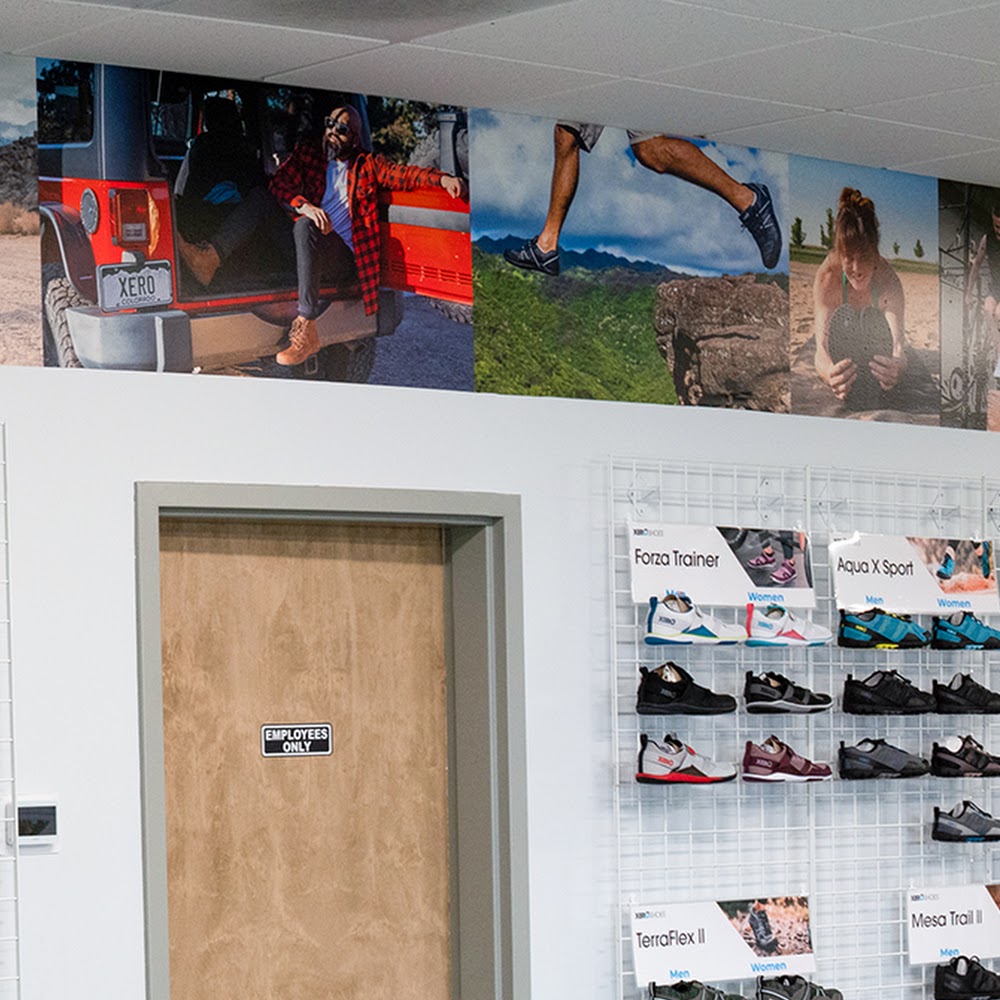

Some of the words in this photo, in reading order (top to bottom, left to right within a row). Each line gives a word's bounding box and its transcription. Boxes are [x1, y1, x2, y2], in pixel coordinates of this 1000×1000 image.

[118, 275, 155, 297] XERO
[635, 548, 670, 565] Forza
[672, 550, 720, 567] Trainer
[837, 557, 869, 576] Aqua
[871, 558, 881, 574] X
[883, 560, 914, 577] Sport
[747, 592, 785, 602] Women
[865, 595, 884, 605] Men
[937, 598, 971, 608] Women
[265, 728, 328, 741] EMPLOYEES
[282, 740, 312, 753] ONLY
[912, 913, 947, 928] Mesa
[949, 910, 974, 925] Trail
[636, 930, 695, 949] TerraFlex
[939, 948, 960, 957] Men
[669, 969, 690, 979] Men
[750, 962, 787, 973] Women
